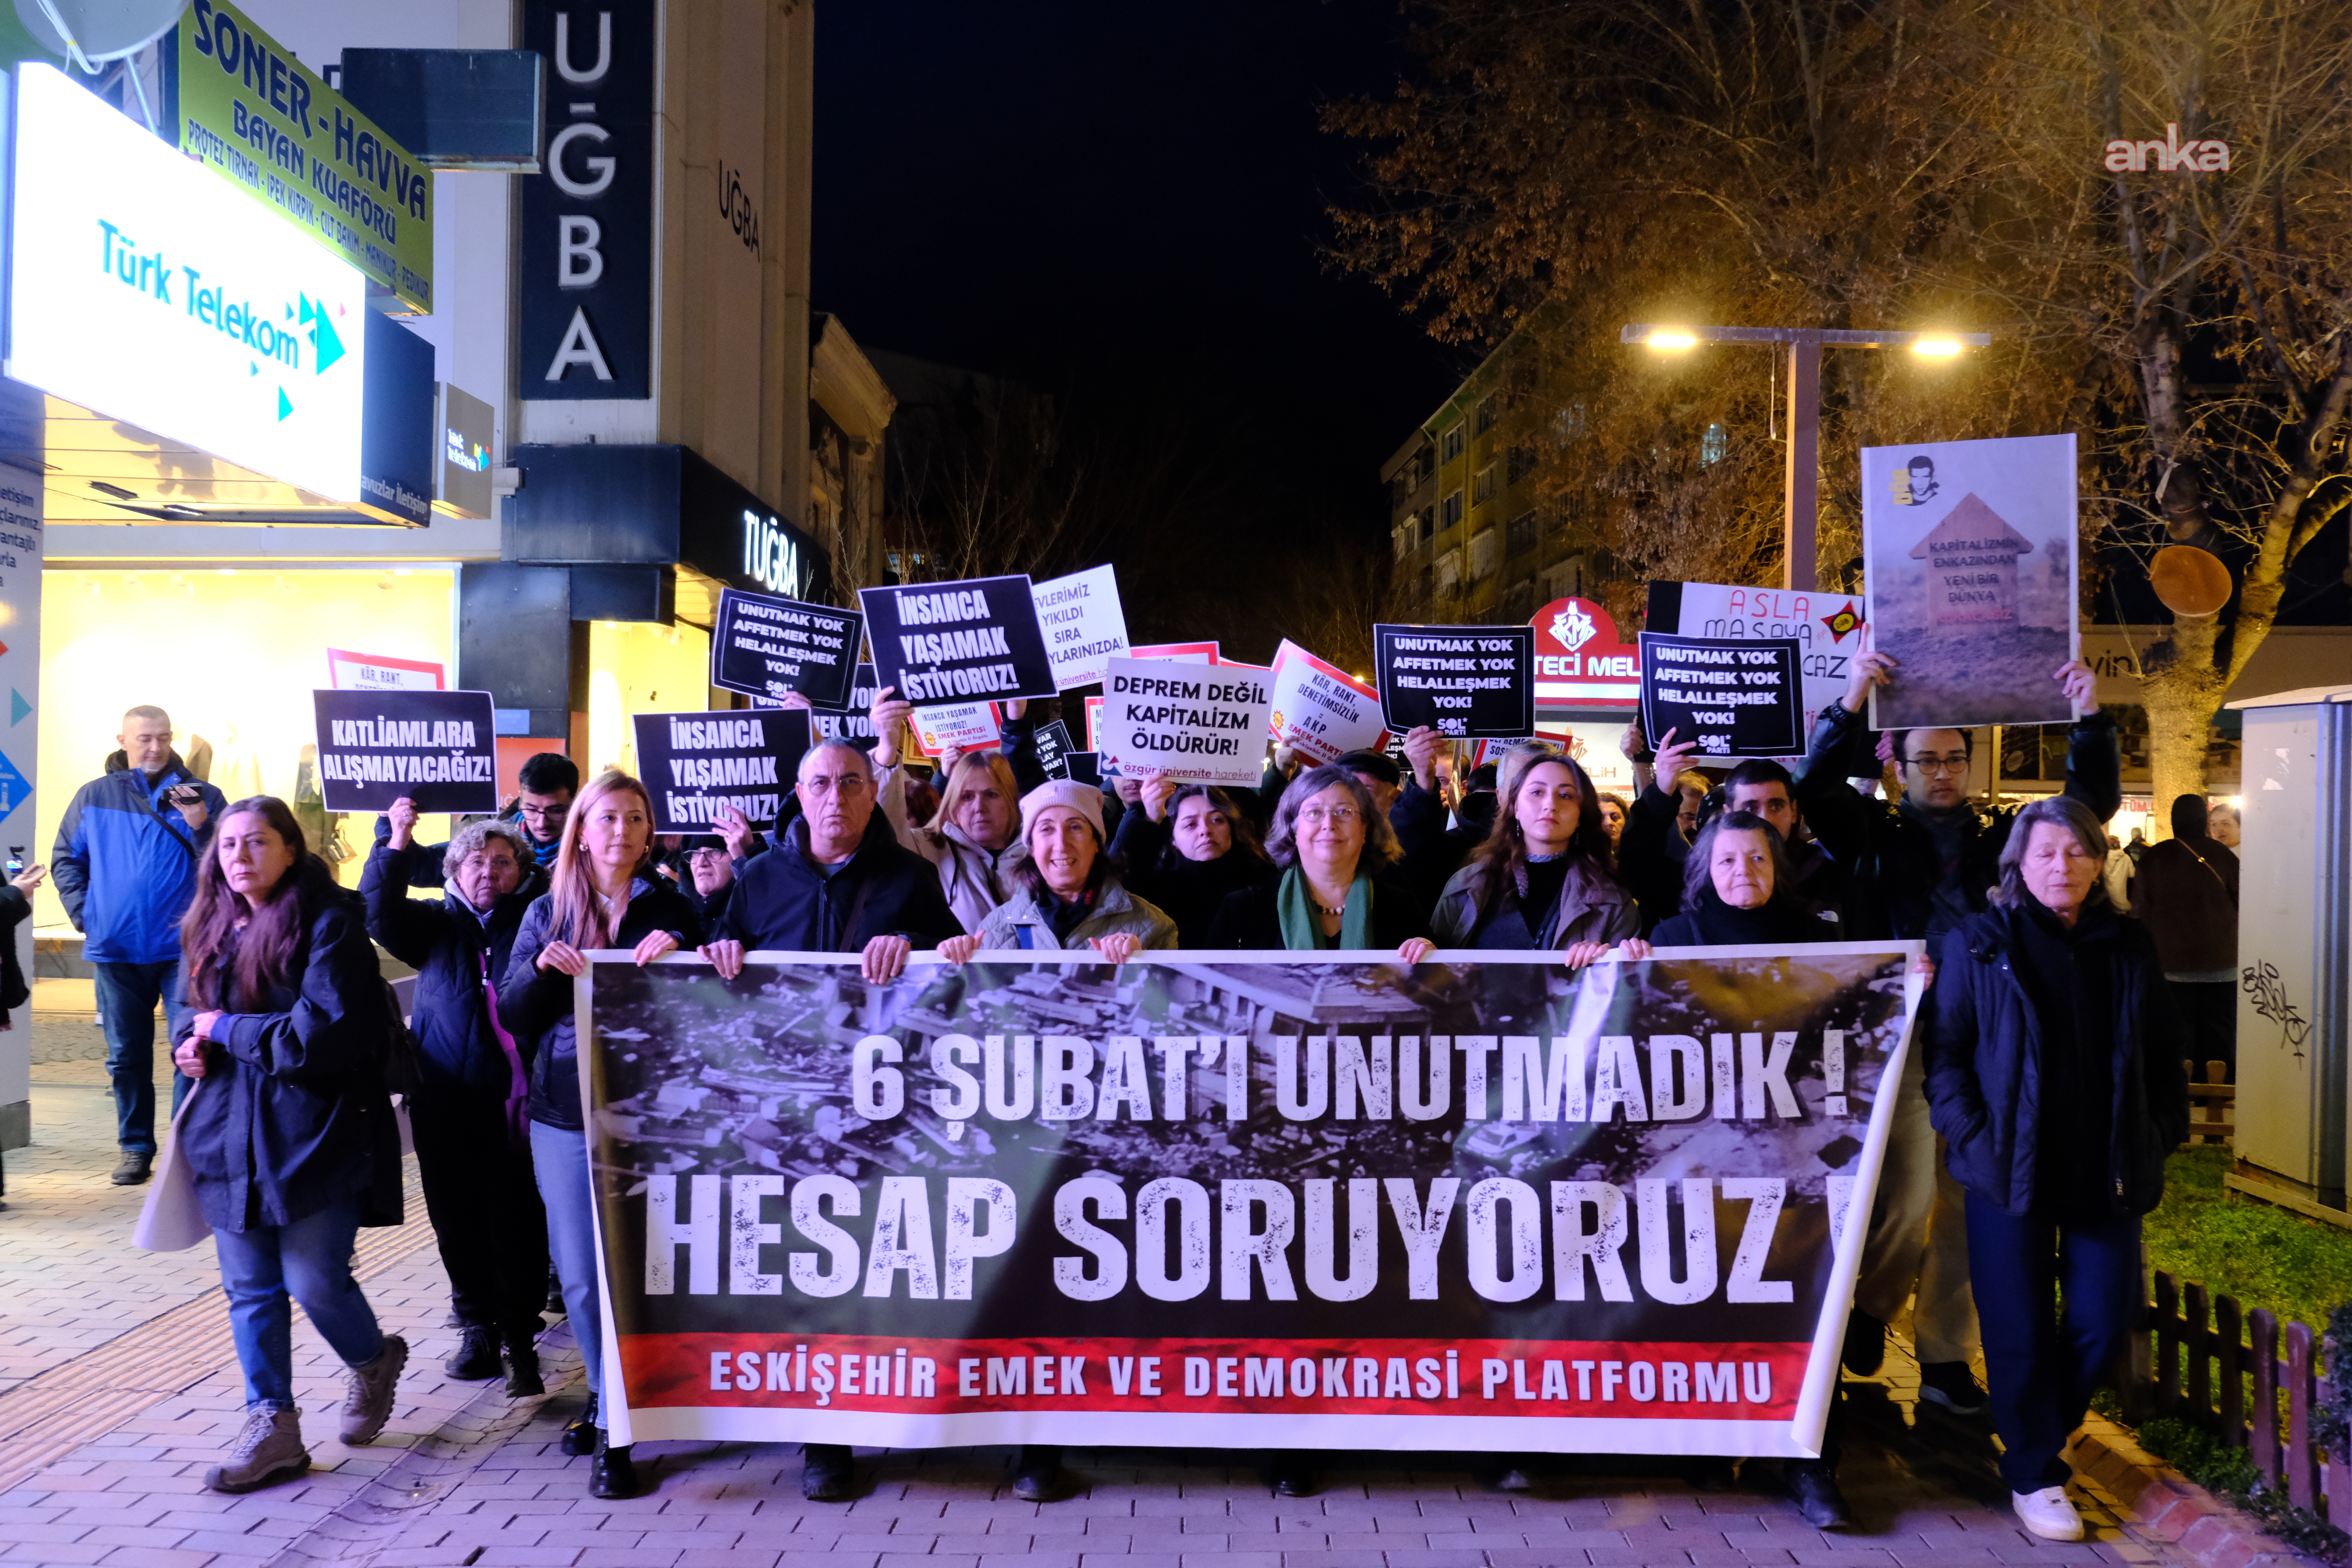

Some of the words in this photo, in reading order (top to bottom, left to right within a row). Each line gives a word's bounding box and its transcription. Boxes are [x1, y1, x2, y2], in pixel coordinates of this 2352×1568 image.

[193, 0, 313, 138] SONER
[335, 106, 426, 222] HAVVA
[188, 116, 225, 167] PROTEZ
[226, 143, 260, 191] TIRNAK
[337, 220, 360, 256] BAKIM
[234, 99, 304, 182] BAYAN
[312, 157, 396, 246] KUAFÖRÜ
[719, 159, 760, 263] UĞBA
[97, 219, 172, 305] Türk
[182, 265, 299, 369] Telekom
[744, 509, 798, 600] TUĞBA
[1943, 572, 1974, 586] YENİ
[1977, 571, 1999, 585] BİR
[738, 602, 811, 626] UNUTMAK
[813, 617, 845, 632] YOK
[894, 589, 991, 626] İNSANCA
[1042, 605, 1084, 627] YIKILDI
[1729, 590, 1810, 622] ASLA
[733, 620, 810, 644] AFFETMEK
[812, 634, 844, 649] YOK
[899, 626, 1011, 666] YAŞAMAK
[1055, 627, 1082, 644] SIRA
[1395, 637, 1475, 652] UNUTMAK
[1478, 639, 1513, 652] YOK
[735, 636, 838, 665] HELALLEŞMEK
[1393, 657, 1477, 671] AFFETMEK
[1480, 658, 1515, 670] YOK
[1656, 647, 1735, 665] UNUTMAK
[1738, 651, 1778, 665] YOK
[766, 660, 800, 677] YOK!
[899, 663, 1020, 700] İSTİYORUZ!
[1060, 671, 1096, 685] üniversite
[1655, 668, 1738, 684] AFFETMEK
[1740, 672, 1781, 684] YOK
[1114, 676, 1201, 699] DEPREM
[1207, 681, 1268, 704] DEĞİL
[1312, 674, 1331, 693] KÂR,
[1333, 685, 1357, 707] RANT,
[1397, 675, 1511, 693] HELALLEŞMEK
[1658, 688, 1778, 708] HELALLEŞMEK
[921, 712, 946, 722] İNSANCA
[946, 706, 977, 720] YAŞAMAK
[1297, 683, 1360, 724] DENETİMSİZLİK
[1432, 696, 1472, 709] YOK!
[332, 715, 476, 747] KATLİAMLARA
[935, 720, 968, 732] İSTİYORUZ!
[957, 726, 986, 736] PARTİSİ
[1126, 704, 1250, 730] KAPİTALİZM
[1303, 716, 1327, 734] AKP
[1437, 718, 1466, 730] SOL
[1692, 712, 1735, 725] YOK!
[669, 716, 765, 750] İNSANCA
[1041, 740, 1058, 752] YOK
[1132, 727, 1239, 755] ÖLDÜRÜR!
[1288, 723, 1314, 743] EMEK
[1698, 735, 1730, 748] SOL
[323, 750, 492, 789] ALIŞMAYACAĞIZ!
[669, 756, 779, 790] YAŞAMAK
[1042, 758, 1063, 772] VAR?
[1124, 761, 1157, 776] özgür
[1159, 766, 1212, 778] üniversite
[1215, 766, 1257, 780] hareketi
[666, 790, 779, 824] İSTİYORUZ!
[852, 1034, 905, 1121] 6
[929, 1033, 1247, 1141] ŞUBAT'I
[1276, 1031, 1802, 1124] UNUTMADIK
[1824, 1029, 1847, 1116] !
[645, 1174, 1017, 1300] HESAP
[1053, 1176, 1795, 1305] SORUYORUZ
[710, 1344, 937, 1406] ESKİŞEHİR
[959, 1355, 1087, 1398] EMEK
[1109, 1356, 1162, 1396] VE
[1184, 1349, 1460, 1401] DEMOKRASİ
[1482, 1358, 1772, 1405] PLATFORMU
